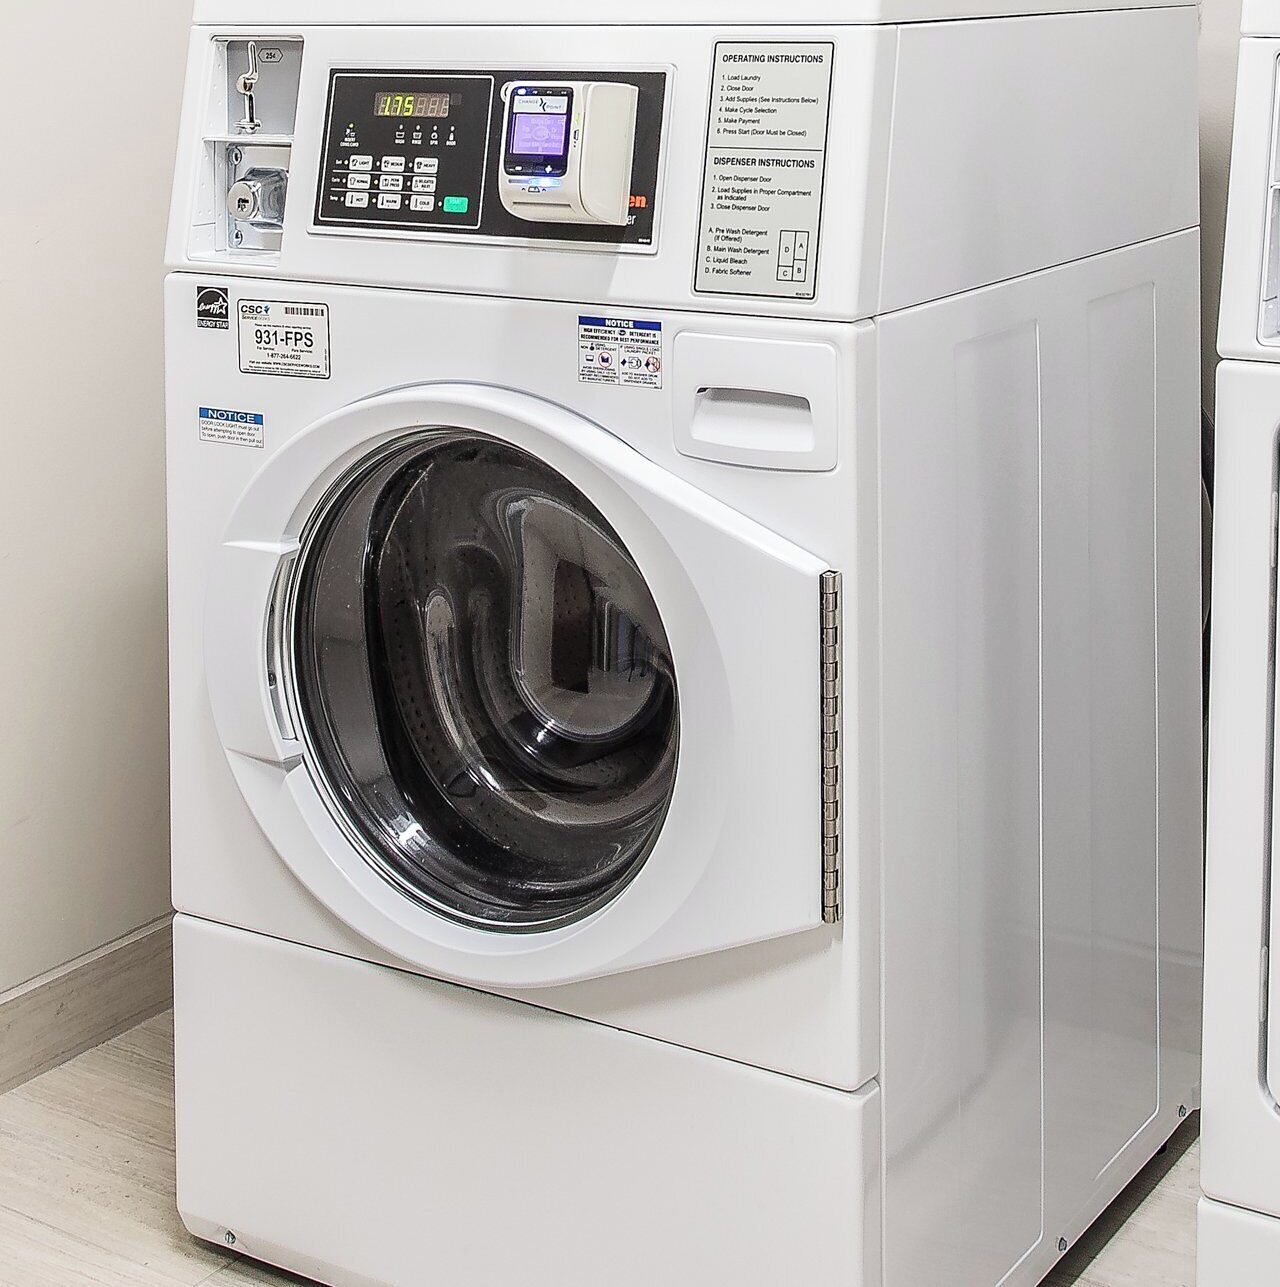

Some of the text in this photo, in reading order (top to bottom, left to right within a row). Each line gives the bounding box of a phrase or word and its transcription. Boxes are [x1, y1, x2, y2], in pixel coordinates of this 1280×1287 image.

[722, 54, 823, 63] OPERATING INSTRUCTIONS
[740, 74, 761, 82] Laundry
[713, 156, 815, 168] DISPENSER INSTRUCTIONS
[240, 304, 262, 314] CSC
[197, 320, 229, 329] ENERGY STAR
[605, 318, 633, 329] NOTICE
[255, 329, 313, 348] 931-FPS
[208, 409, 256, 422] NOTICE
